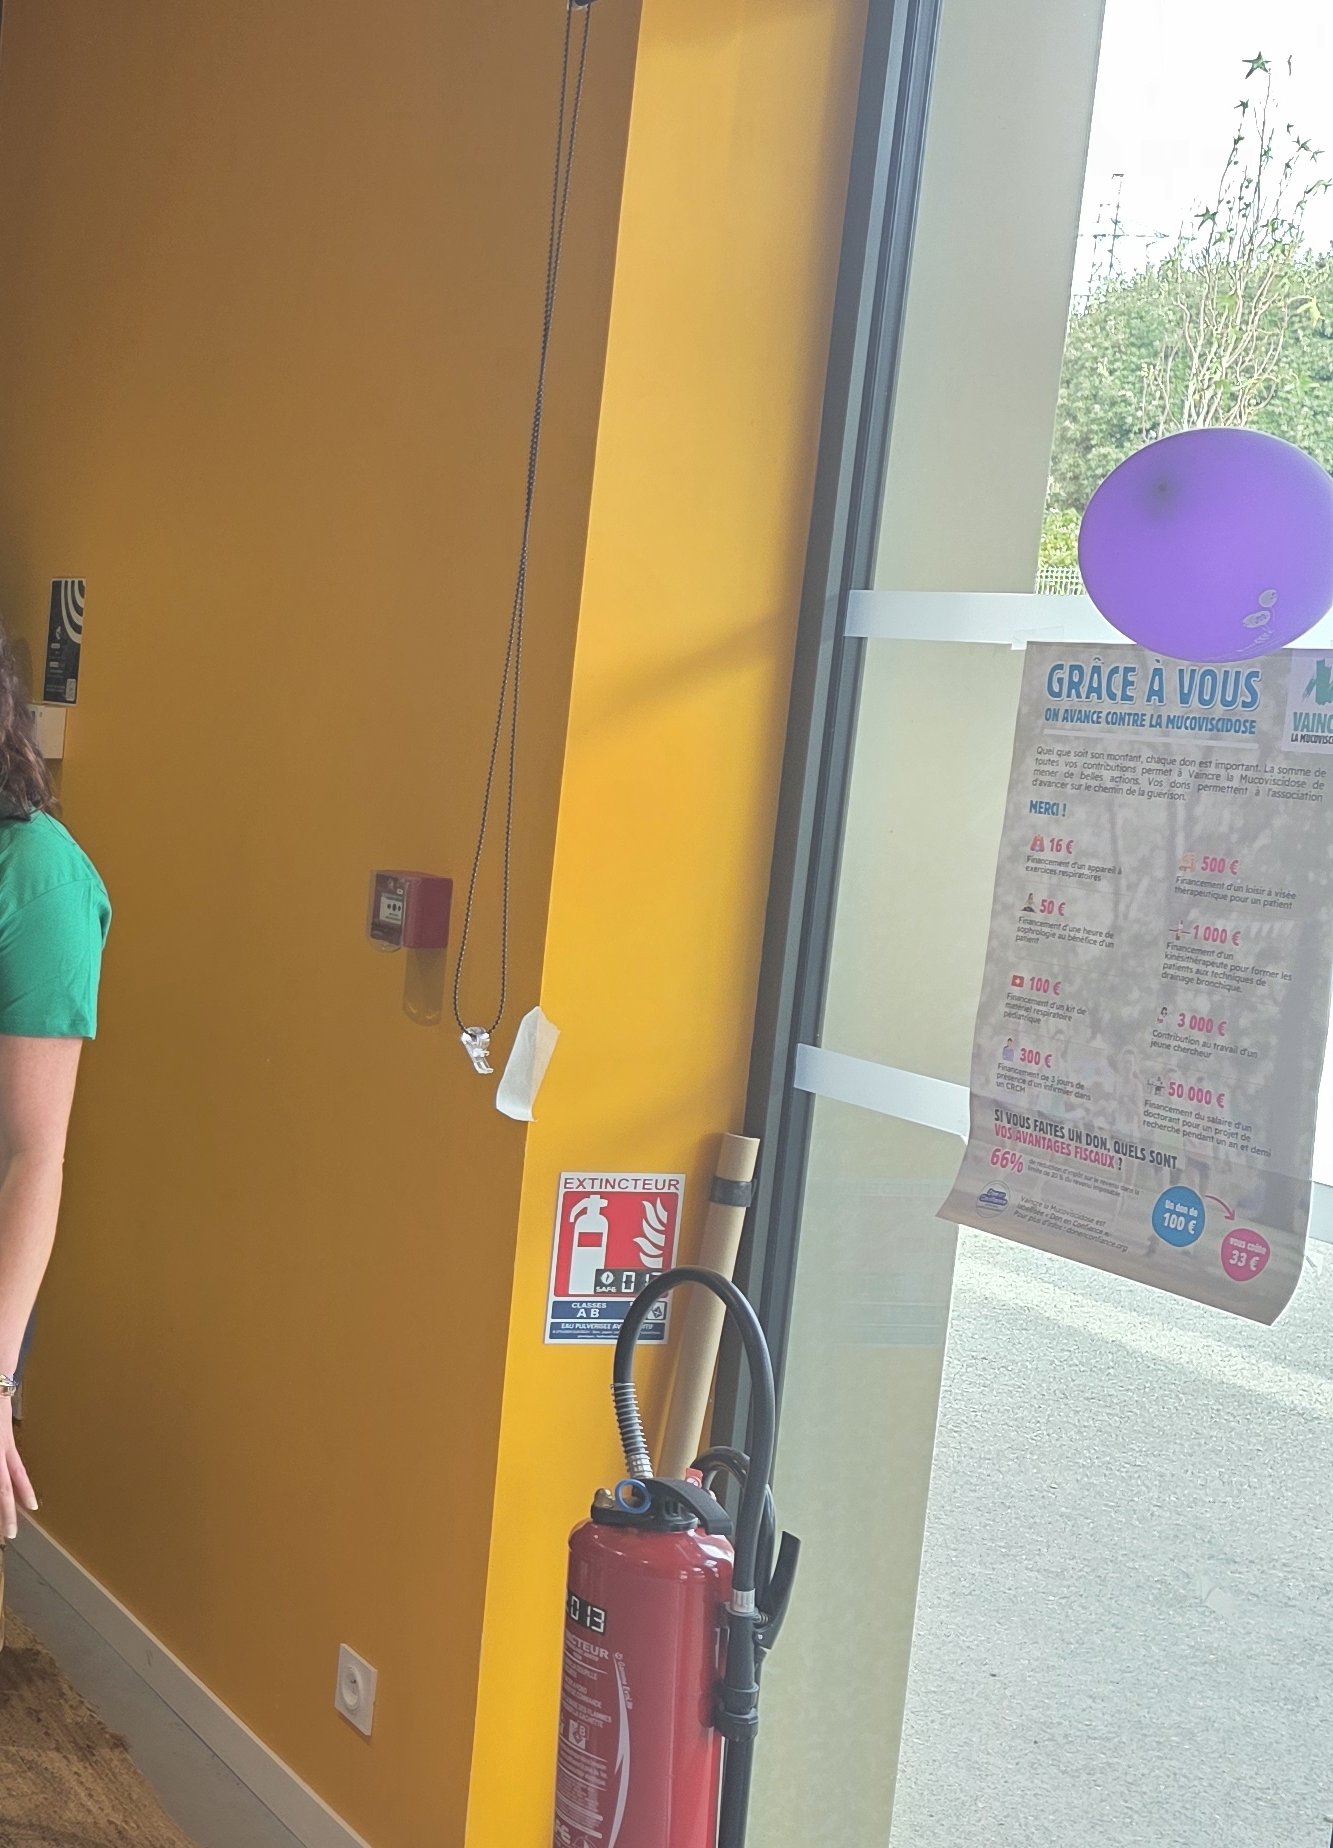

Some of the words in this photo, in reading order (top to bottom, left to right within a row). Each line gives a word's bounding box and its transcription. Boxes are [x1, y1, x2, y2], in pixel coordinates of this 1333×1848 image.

[1046, 657, 1137, 703] GRÂCE
[1145, 659, 1166, 705] À
[1178, 667, 1261, 710] VOUS
[1044, 707, 1059, 722] ON
[1062, 708, 1102, 725] AVANCE
[1105, 710, 1146, 728] CONTRE
[1149, 713, 1163, 729] LA
[1166, 715, 1256, 735] MUCOVISCIDOSE
[1293, 711, 1333, 734] VAINC
[1291, 732, 1299, 742] LA
[1036, 746, 1054, 756] Quel
[1056, 749, 1071, 758] que
[1074, 749, 1088, 758] soit
[1090, 751, 1104, 760] son
[1107, 753, 1144, 764] montant,
[1146, 755, 1177, 767] chaque
[1179, 757, 1196, 767] don
[1199, 760, 1212, 768] est
[1215, 759, 1261, 773] important.
[1264, 764, 1274, 774] La
[1277, 766, 1311, 777] somme
[1314, 768, 1327, 778] de
[1029, 800, 1060, 816] MERCI
[1062, 803, 1067, 817] !
[1049, 838, 1063, 852] 16
[1065, 840, 1074, 854] €
[1201, 856, 1226, 873] 500
[1229, 860, 1239, 875] €
[1039, 899, 1054, 914] 50
[1058, 902, 1066, 916] €
[1193, 925, 1200, 940] 1
[1203, 926, 1227, 944] 000
[1232, 931, 1241, 946] €
[1029, 976, 1050, 993] 100
[1053, 982, 1061, 995] €
[1178, 1013, 1186, 1028] 3
[1189, 1015, 1213, 1033] 000
[1217, 1021, 1227, 1036] €
[1020, 1048, 1041, 1066] 300
[1045, 1054, 1052, 1068] €
[1168, 1082, 1183, 1098] 50
[1188, 1086, 1212, 1105] 000
[1216, 1093, 1225, 1108] €
[994, 1109, 1004, 1122] SI
[1005, 1112, 1031, 1130] VOUS
[1033, 1118, 1065, 1140] FAITES
[1068, 1127, 1083, 1143] UN
[1085, 1131, 1111, 1152] DON,
[1113, 1139, 1146, 1162] QUELS
[1149, 1149, 1177, 1170] SONT
[994, 1124, 1013, 1140] VOS
[1015, 1131, 1072, 1156] AVANTAGES
[1074, 1145, 1115, 1169] FISCAUX
[1118, 1158, 1123, 1170] ?
[990, 1148, 1024, 1174] 66%
[564, 1178, 679, 1191] EXTINCTEUR
[1165, 1199, 1174, 1210] Un
[1175, 1203, 1188, 1214] don
[1189, 1207, 1198, 1217] de
[1164, 1212, 1185, 1230] 100
[1188, 1220, 1197, 1234] €
[1229, 1249, 1247, 1266] 33
[1250, 1256, 1259, 1271] €
[622, 1272, 663, 1293] 01
[576, 1309, 587, 1318] A
[590, 1309, 600, 1318] B
